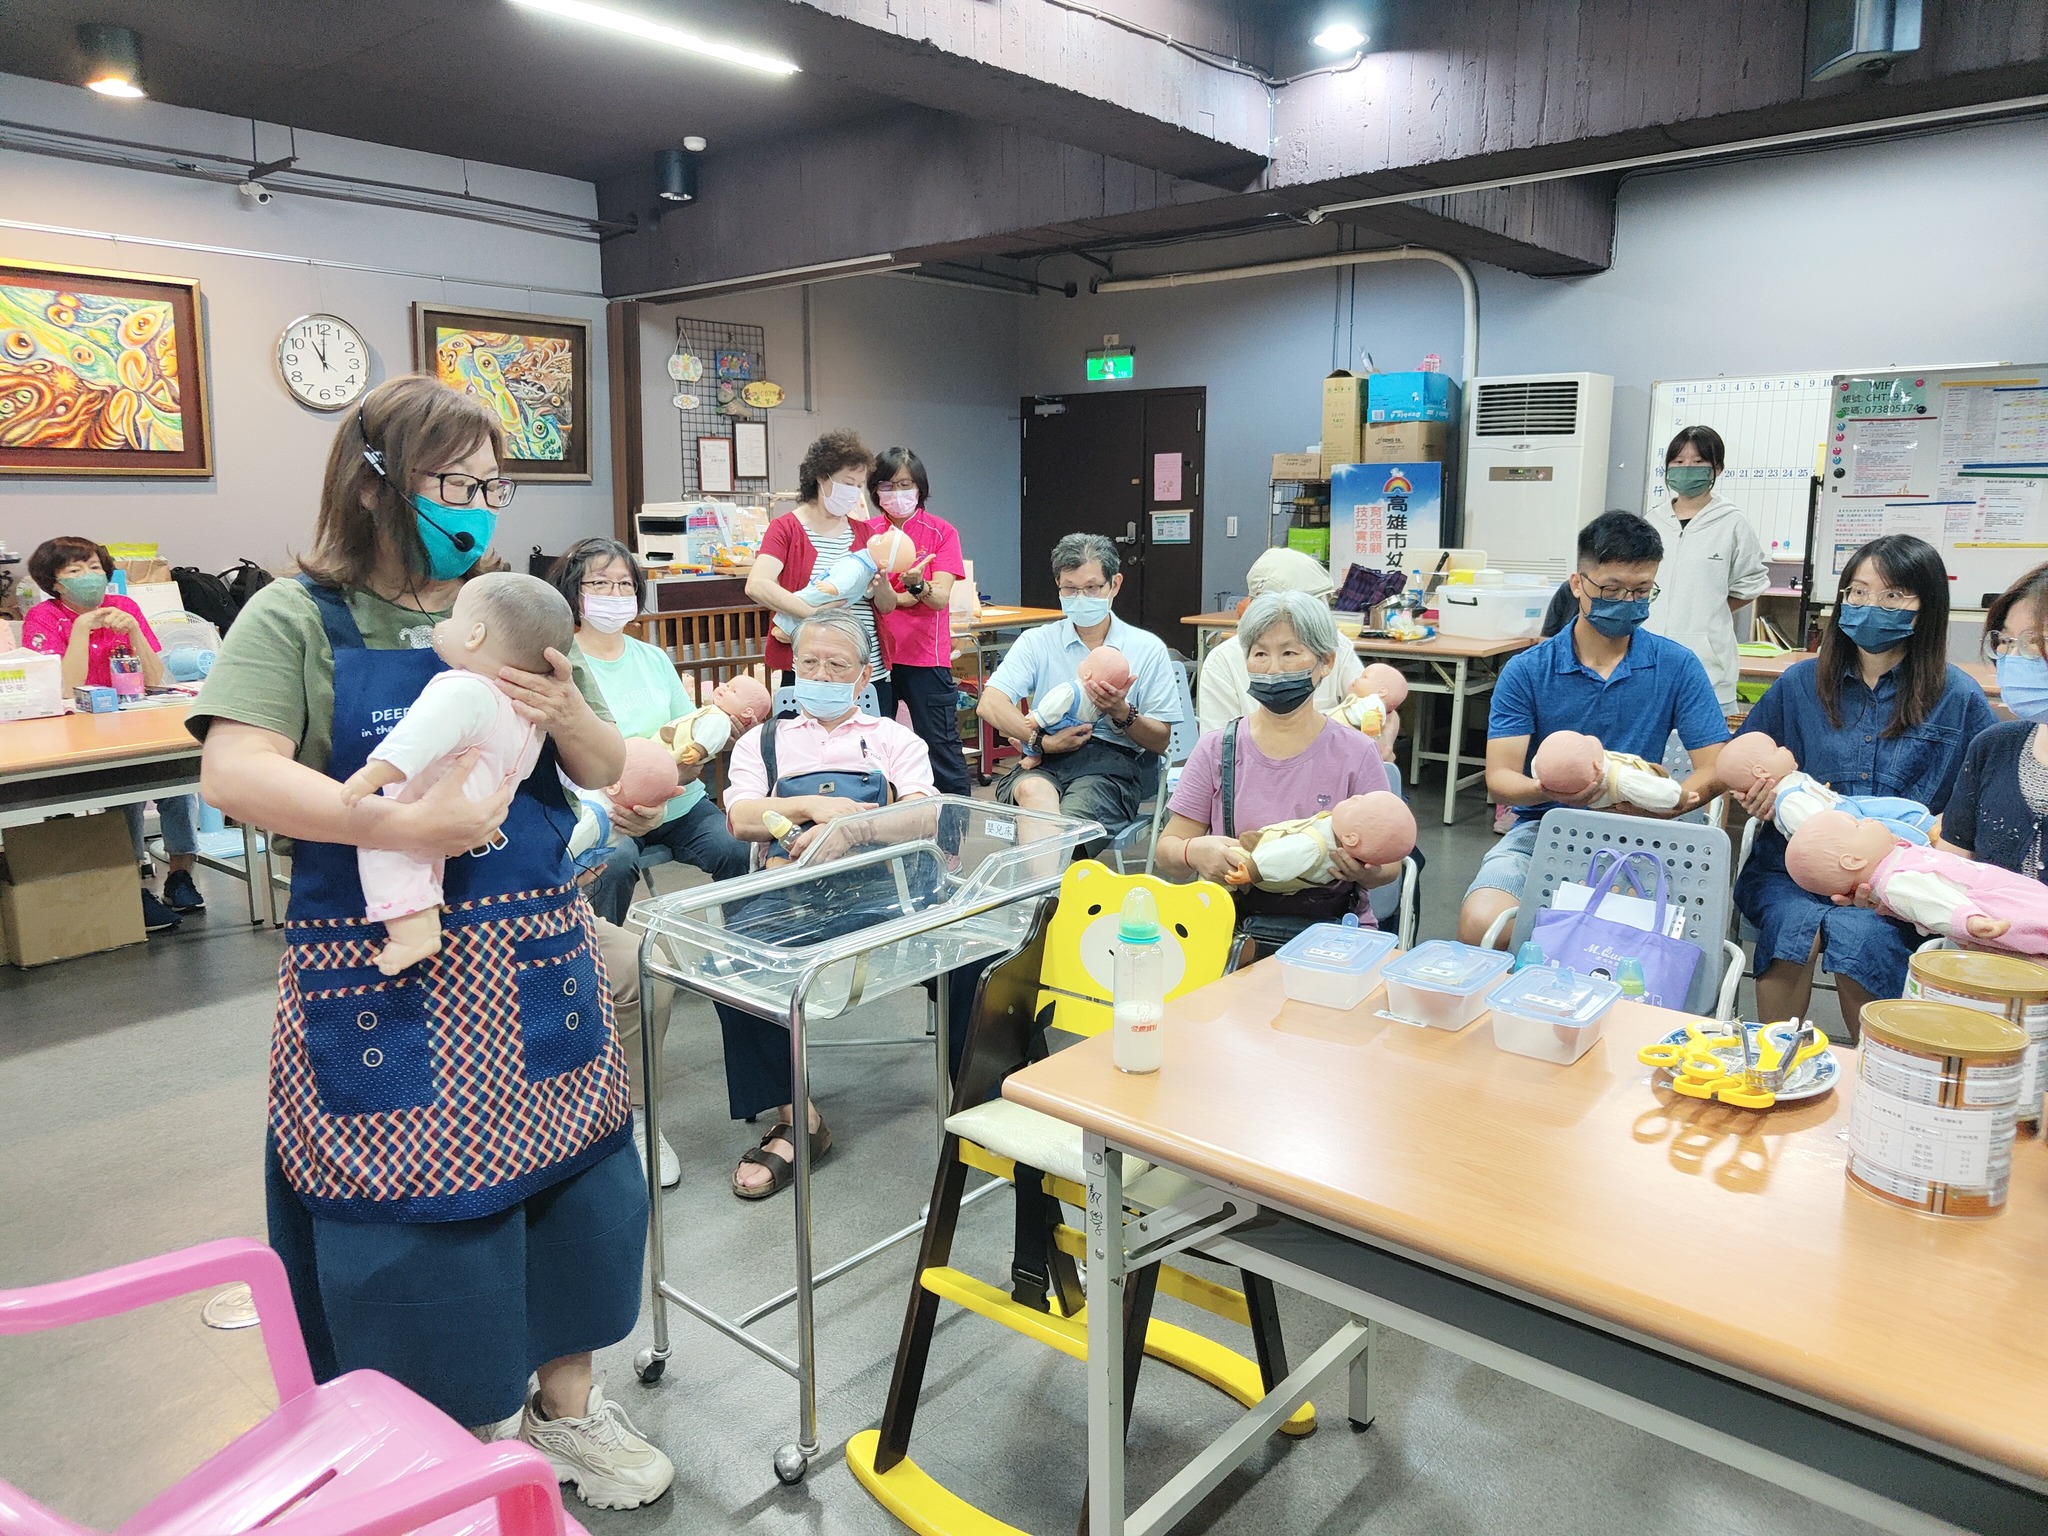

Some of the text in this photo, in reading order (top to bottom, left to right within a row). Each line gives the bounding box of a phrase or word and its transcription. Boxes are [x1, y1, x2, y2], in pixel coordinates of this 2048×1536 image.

[302, 326, 312, 338] 11
[316, 323, 331, 336] 12
[336, 329, 340, 340] 1
[290, 337, 305, 349] 10
[344, 341, 355, 353] 2
[286, 354, 298, 366] 9
[348, 358, 360, 370] 3
[291, 371, 302, 382] 8
[345, 374, 355, 385] 4
[303, 383, 315, 395] 7
[335, 385, 346, 397] 5
[1706, 384, 1712, 392] 2
[1720, 383, 1726, 391] 3
[1734, 383, 1740, 391] 4
[1750, 382, 1756, 390] 5
[1764, 382, 1770, 390] 6
[1779, 381, 1785, 389] 7
[1793, 380, 1800, 388] 8
[1823, 379, 1832, 387] 10
[320, 388, 331, 400] 6
[1724, 469, 1809, 478] 20 21 22 23 24 25
[1355, 506, 1368, 554] 技巧實務
[1369, 506, 1382, 554] 育兒照顧
[1386, 495, 1408, 574] 高雄市幼
[361, 728, 373, 738] in
[987, 822, 1013, 837] 嬰兒床
